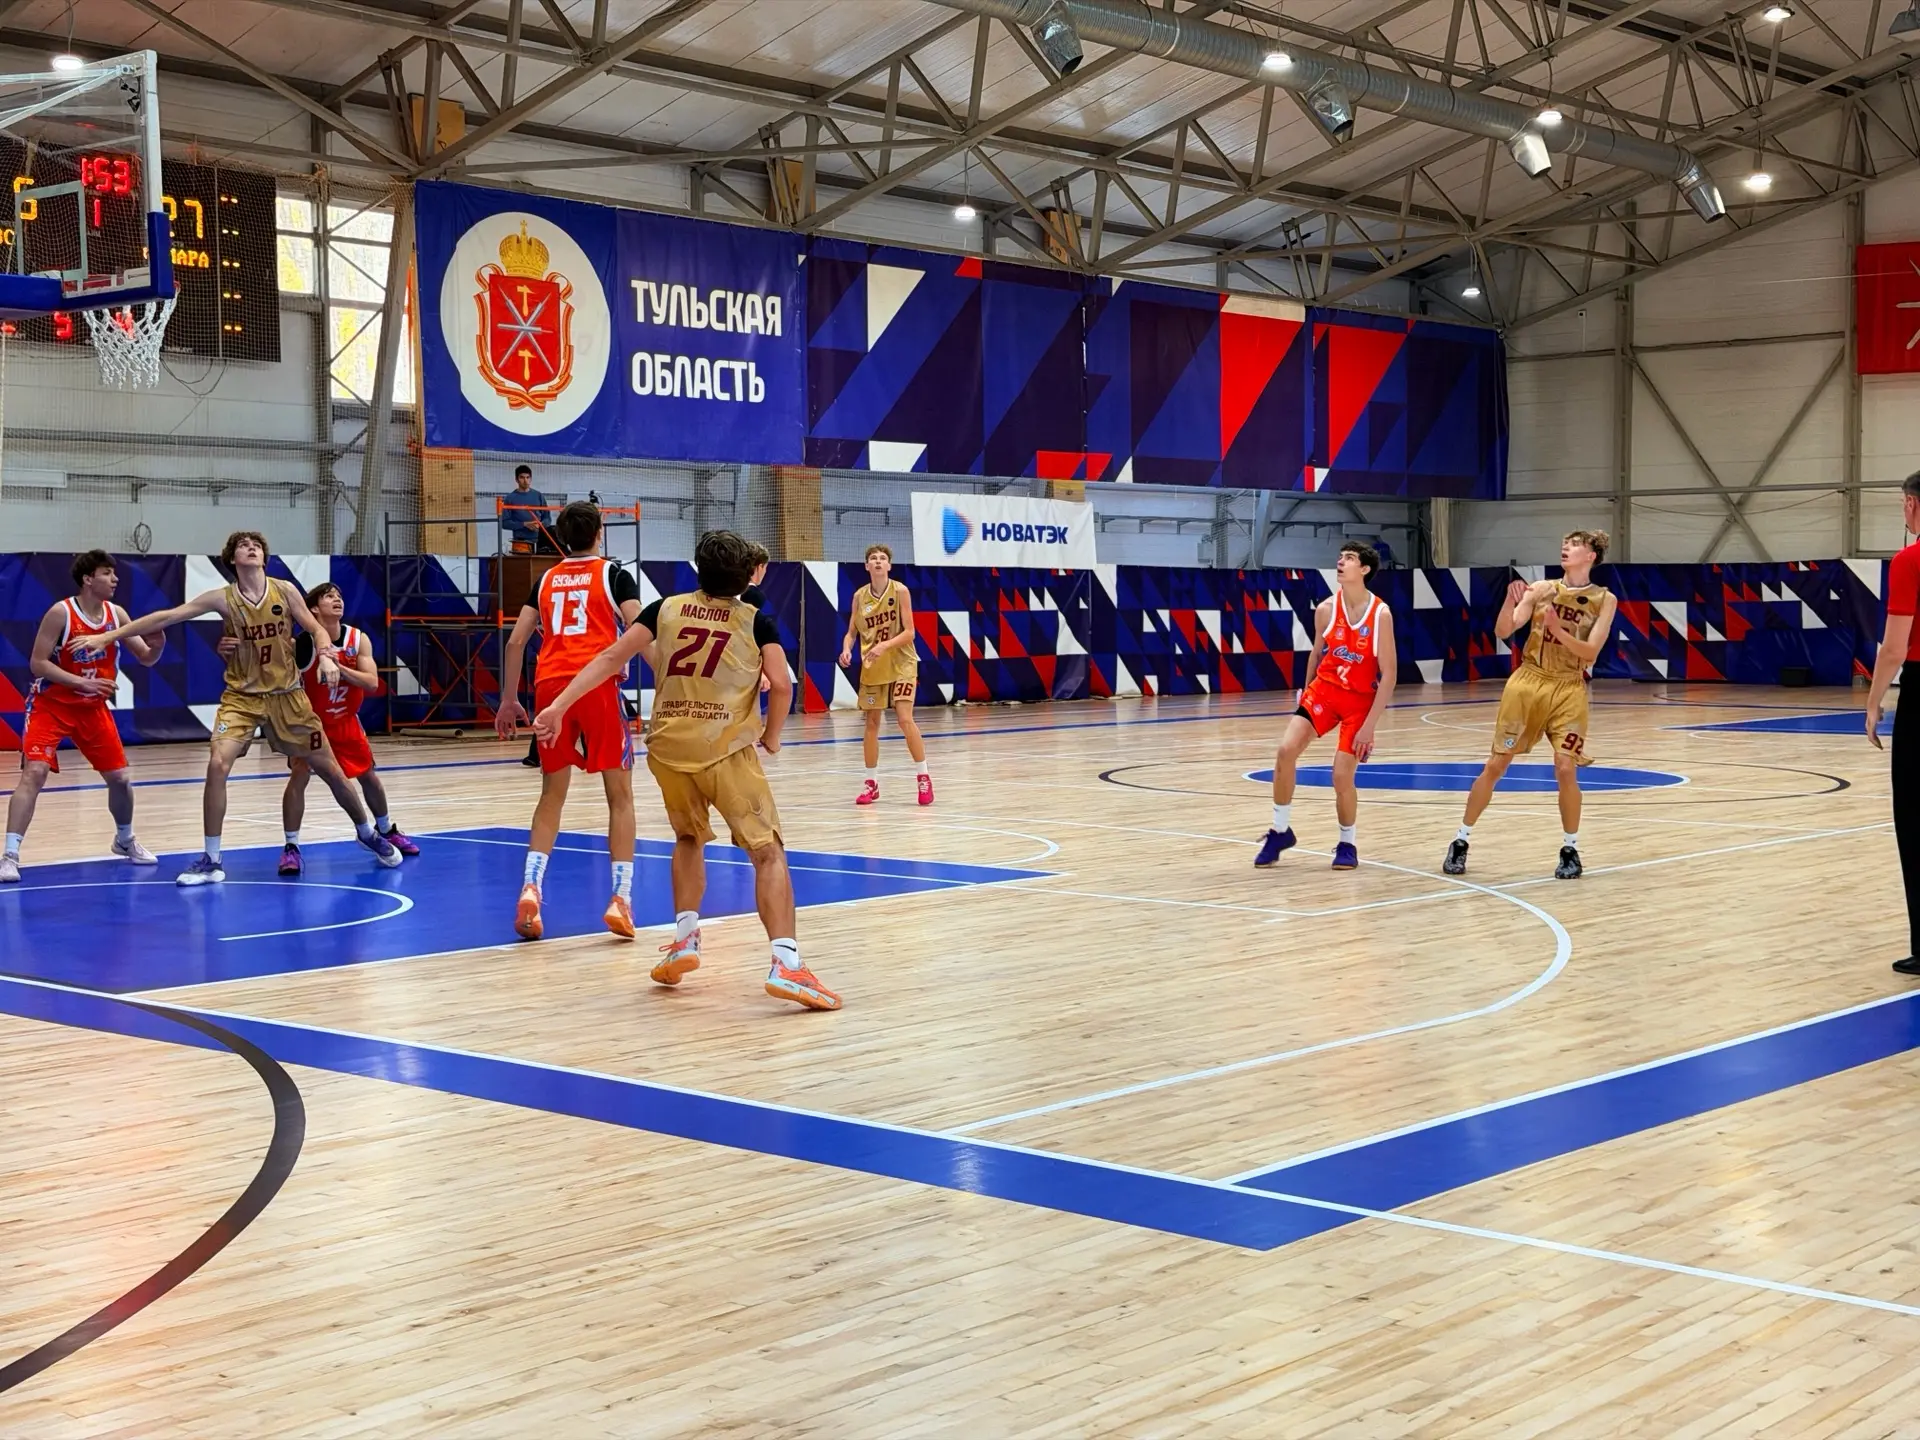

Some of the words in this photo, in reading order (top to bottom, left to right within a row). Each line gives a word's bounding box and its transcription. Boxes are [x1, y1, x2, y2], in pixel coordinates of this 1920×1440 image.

[631, 279, 782, 336] ТУЛЬСКАЯ
[631, 351, 766, 403] ОБЛАСТЬ
[981, 522, 1069, 545] НОВАТЭК
[551, 572, 593, 588] БУЗЫКИН
[551, 590, 589, 636] 13
[680, 604, 731, 622] МАСЛОВ
[260, 644, 272, 665] 8
[894, 682, 914, 697] 36
[662, 700, 725, 711] ПРАВИТЕЛЬСТВО
[691, 710, 730, 721] ОБЛАСТИ
[310, 731, 322, 750] 8
[1561, 732, 1585, 754] 92
